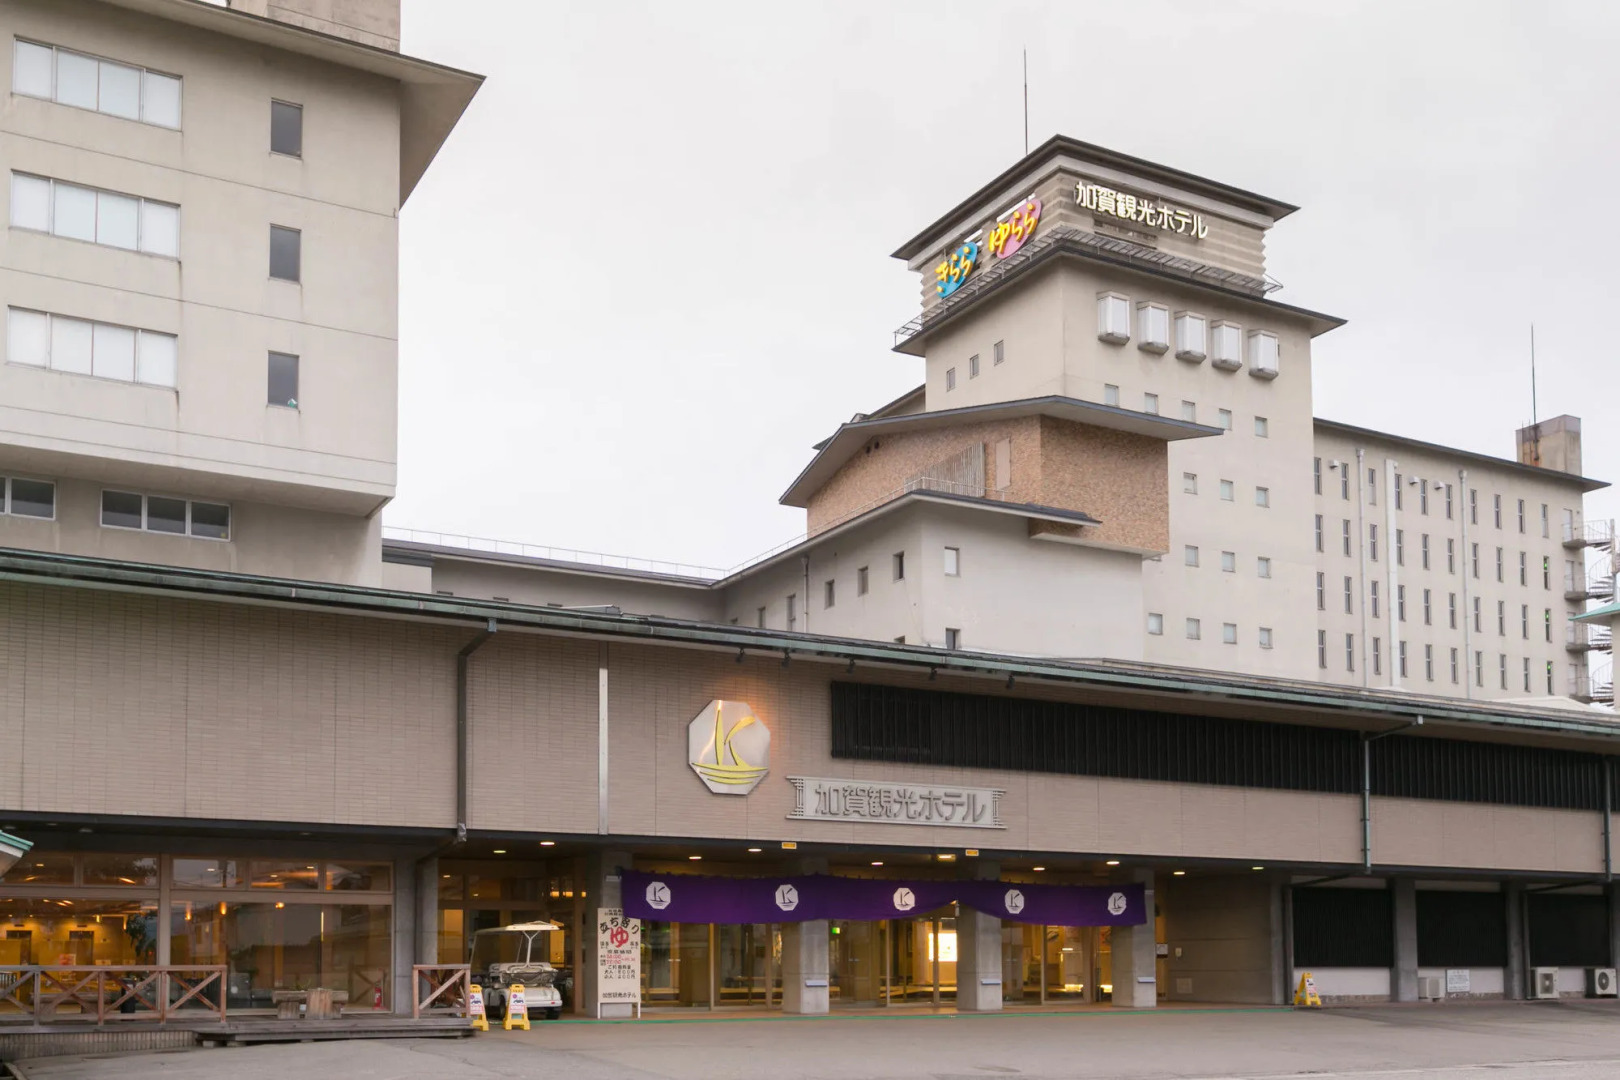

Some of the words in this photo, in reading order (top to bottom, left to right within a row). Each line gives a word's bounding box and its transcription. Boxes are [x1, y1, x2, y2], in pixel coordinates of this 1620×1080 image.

[988, 203, 1037, 255] ゆらら
[1076, 181, 1209, 239] 加賀観光ホテル
[935, 246, 972, 292] きらら
[814, 783, 987, 823] 加賀観光ホテル
[610, 926, 629, 948] ゆ
